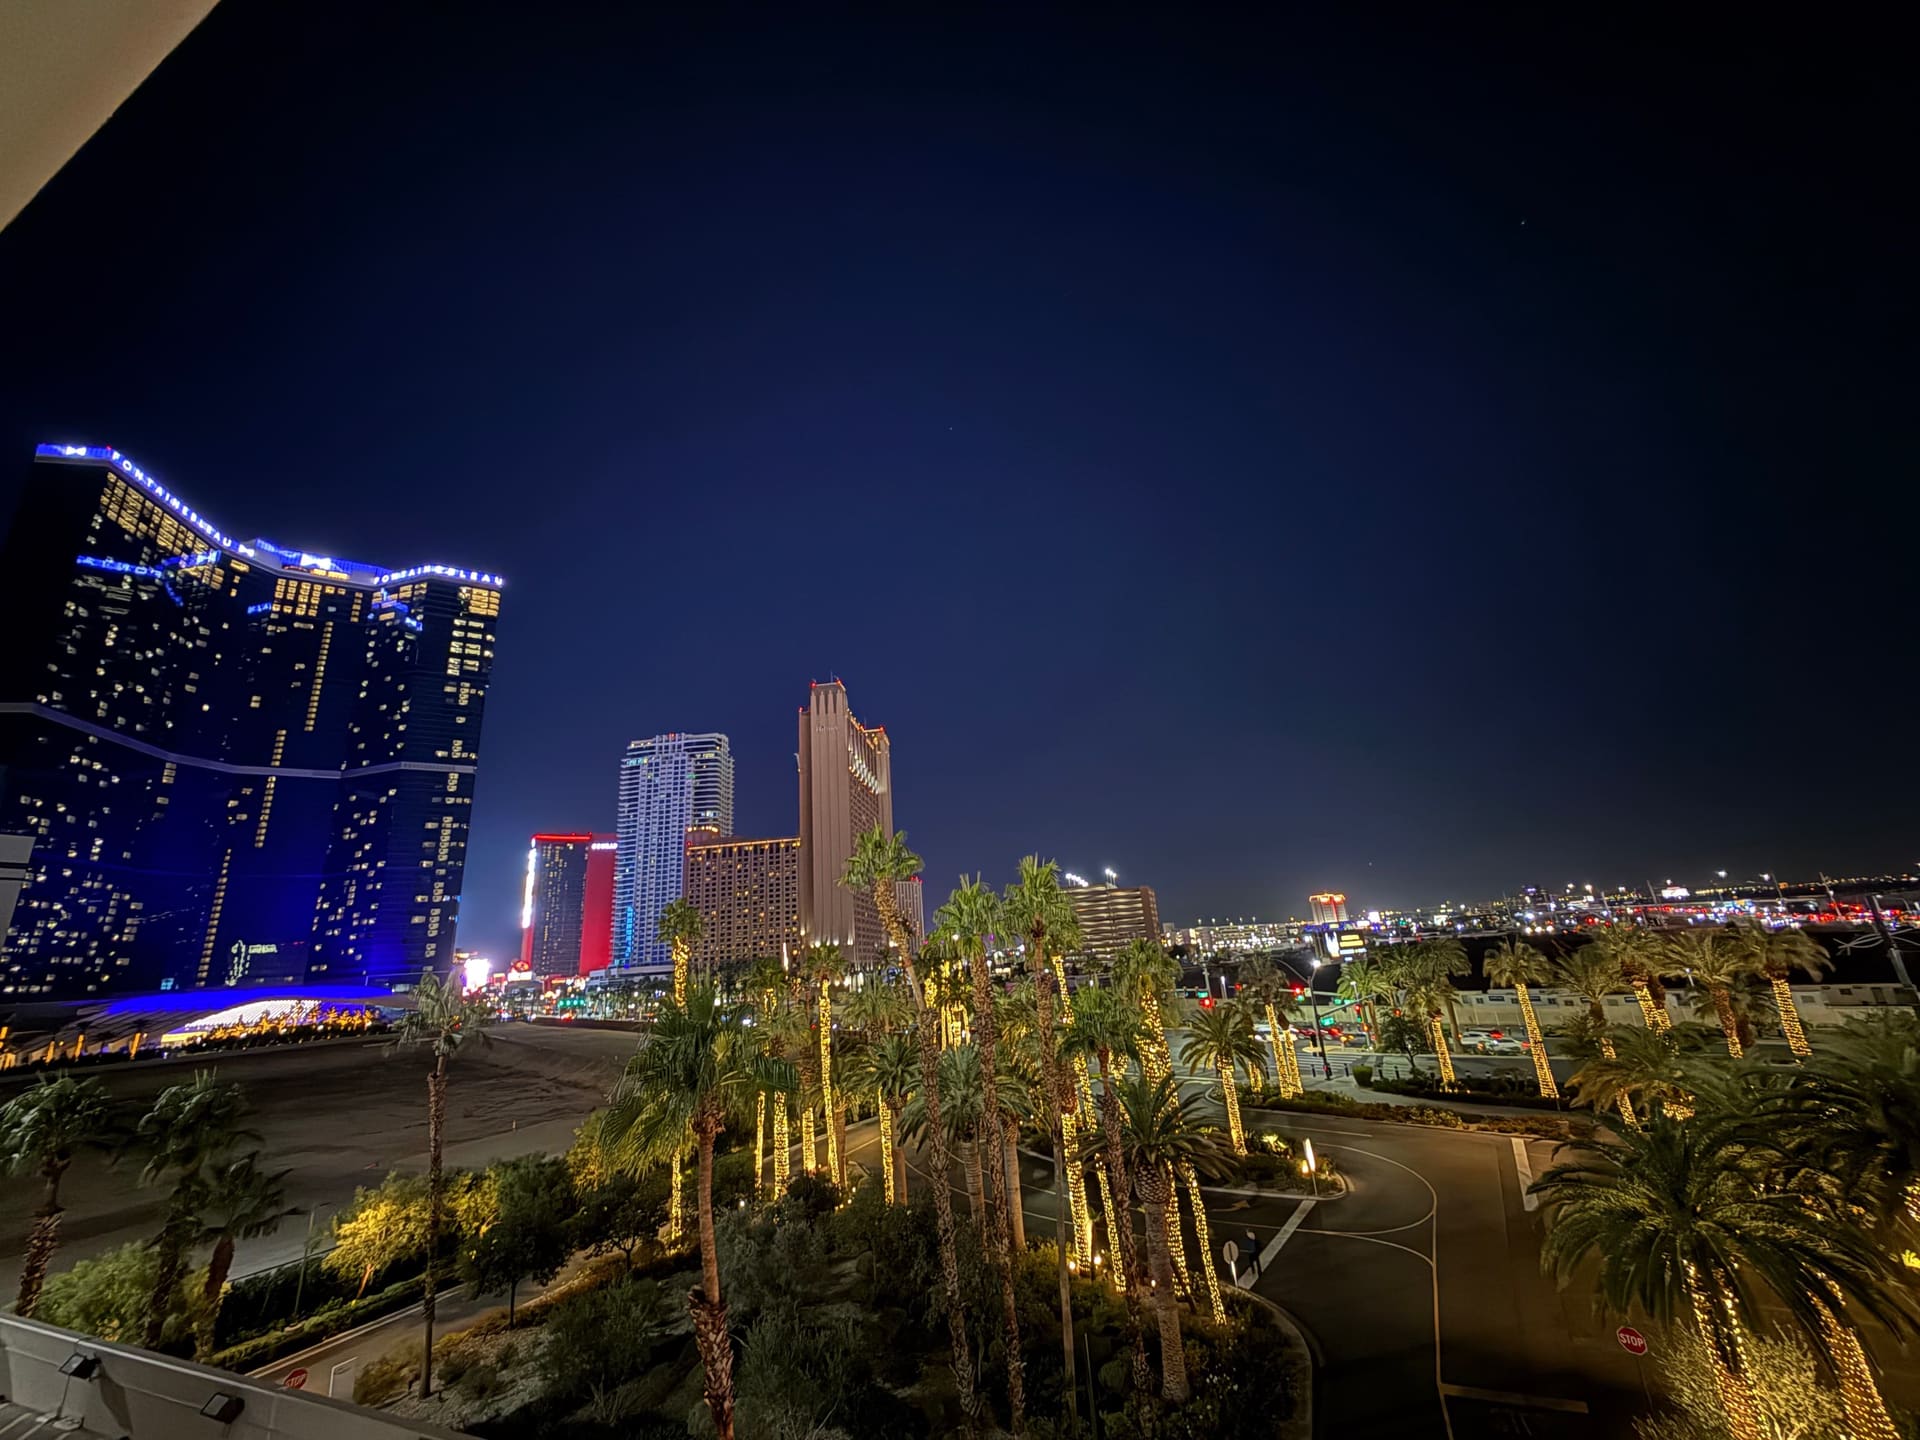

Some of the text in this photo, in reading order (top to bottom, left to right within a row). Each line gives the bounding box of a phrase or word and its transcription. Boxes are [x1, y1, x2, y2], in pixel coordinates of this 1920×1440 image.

[111, 450, 233, 548] FONTAINEBLEAU
[1619, 1332, 1644, 1348] STOP
[284, 1373, 307, 1388] STOP
